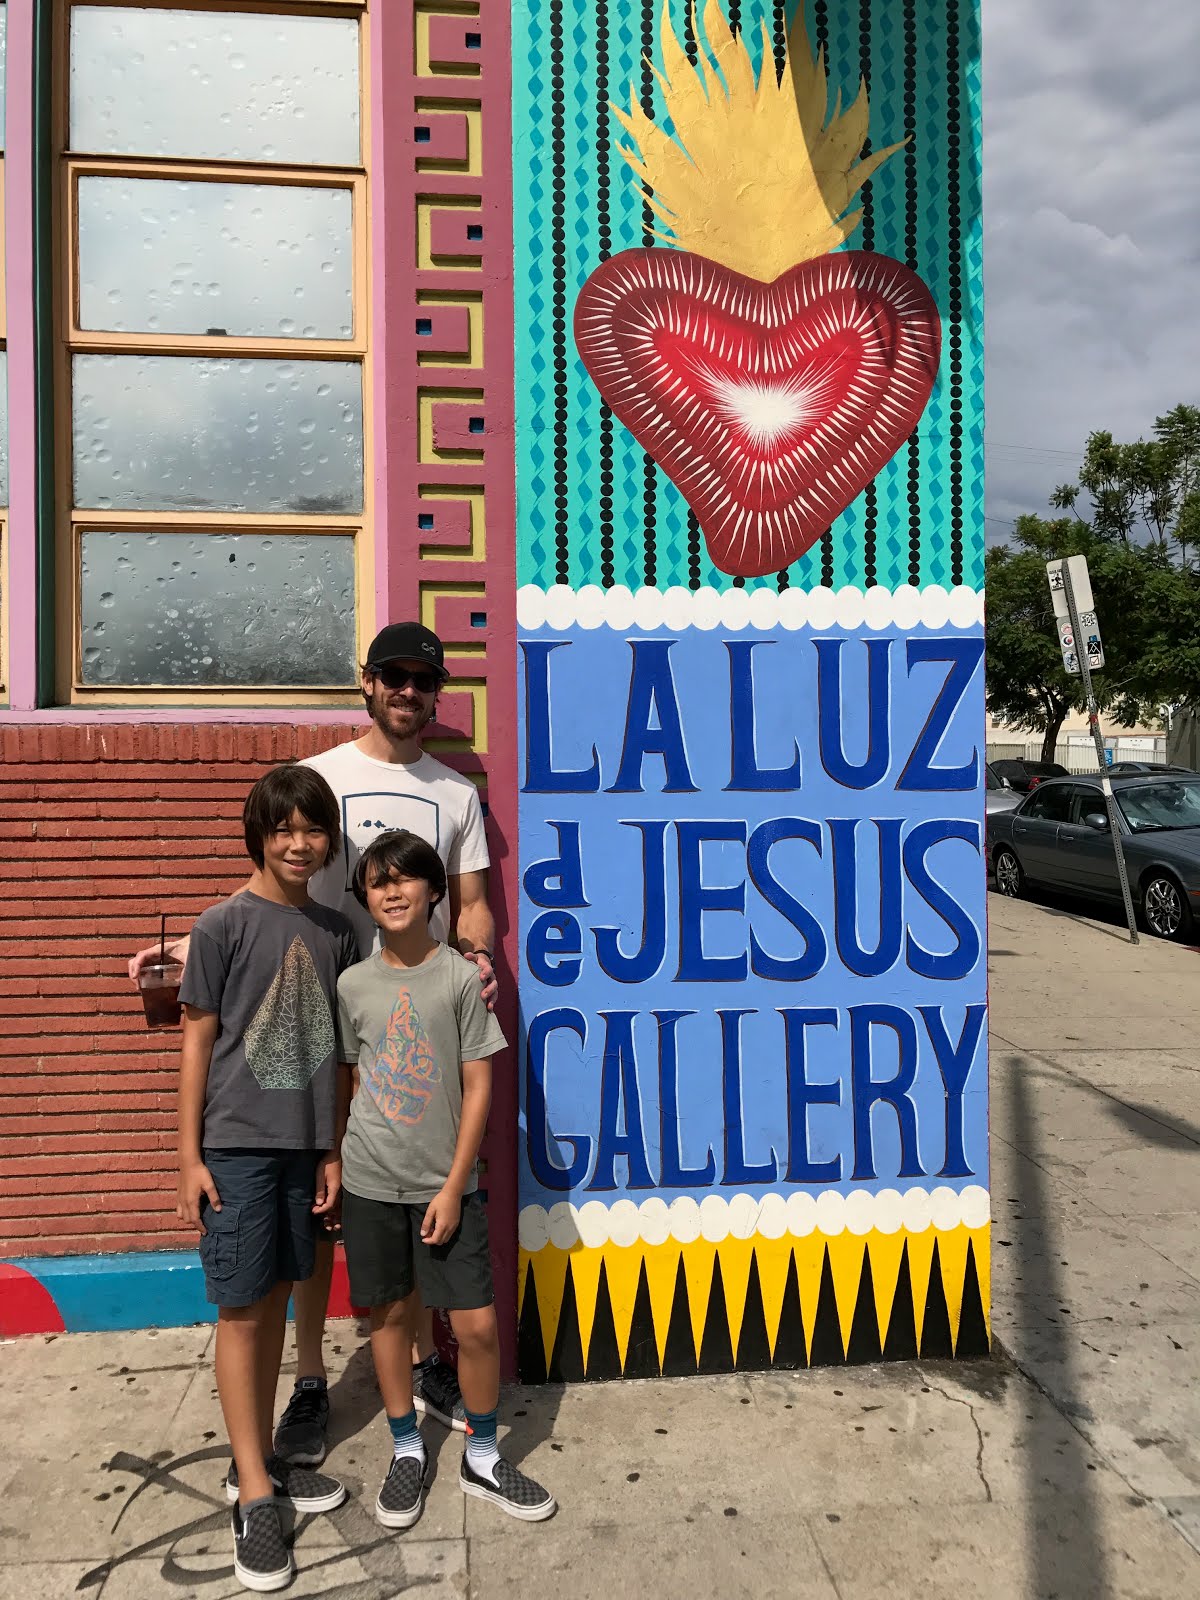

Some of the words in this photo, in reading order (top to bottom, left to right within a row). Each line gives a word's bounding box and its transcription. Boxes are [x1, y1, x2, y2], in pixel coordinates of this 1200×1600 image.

[517, 637, 702, 794] LA
[721, 636, 986, 793] LUZ
[589, 816, 982, 984] JESUS
[525, 1002, 988, 1193] GALLERY
